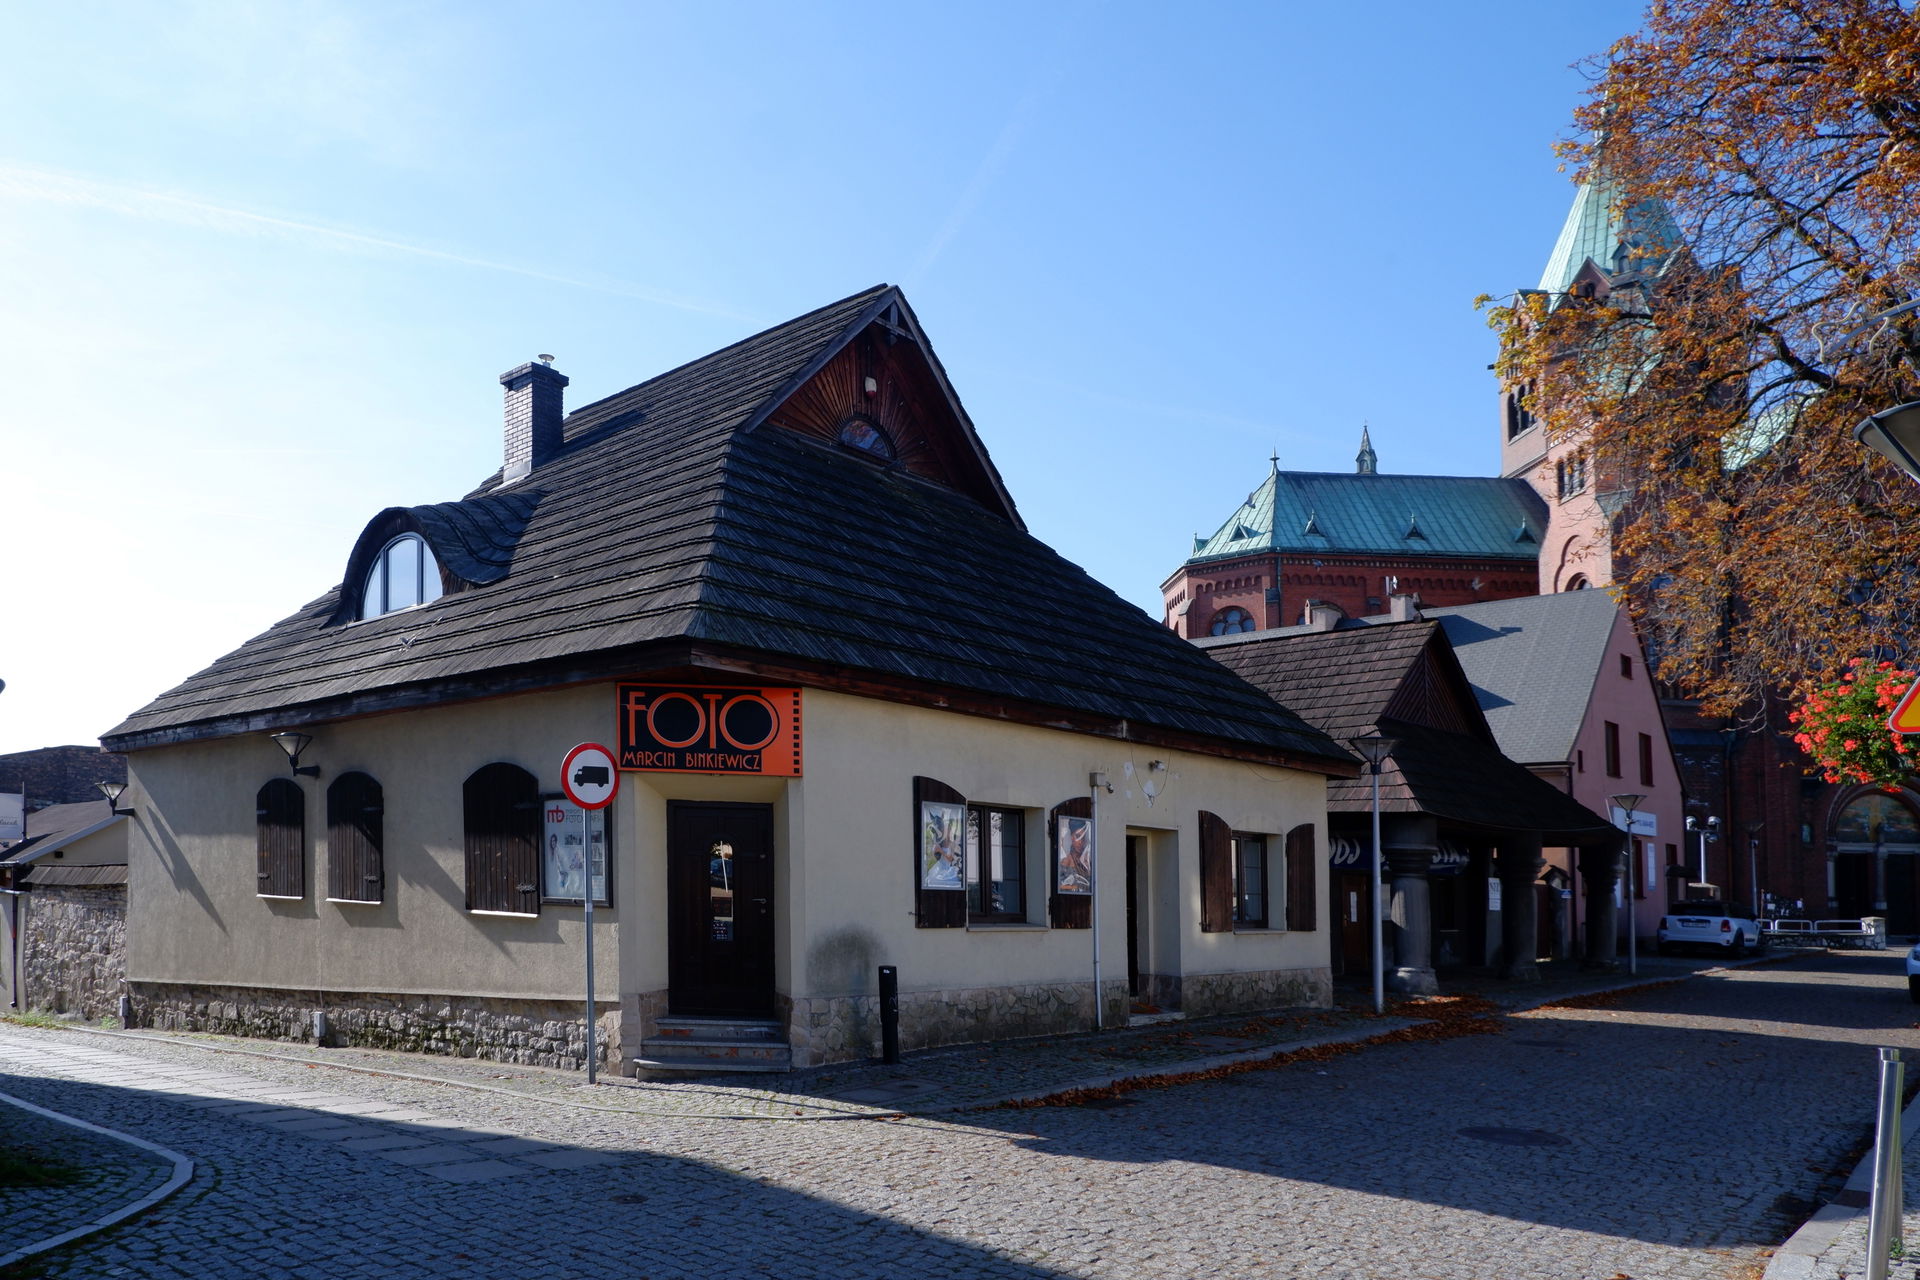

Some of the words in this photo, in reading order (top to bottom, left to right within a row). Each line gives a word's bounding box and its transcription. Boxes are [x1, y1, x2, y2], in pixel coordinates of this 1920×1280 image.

[626, 691, 780, 750] FOTO
[622, 751, 675, 767] MARCIN
[685, 752, 761, 770] BINKIEWICZ
